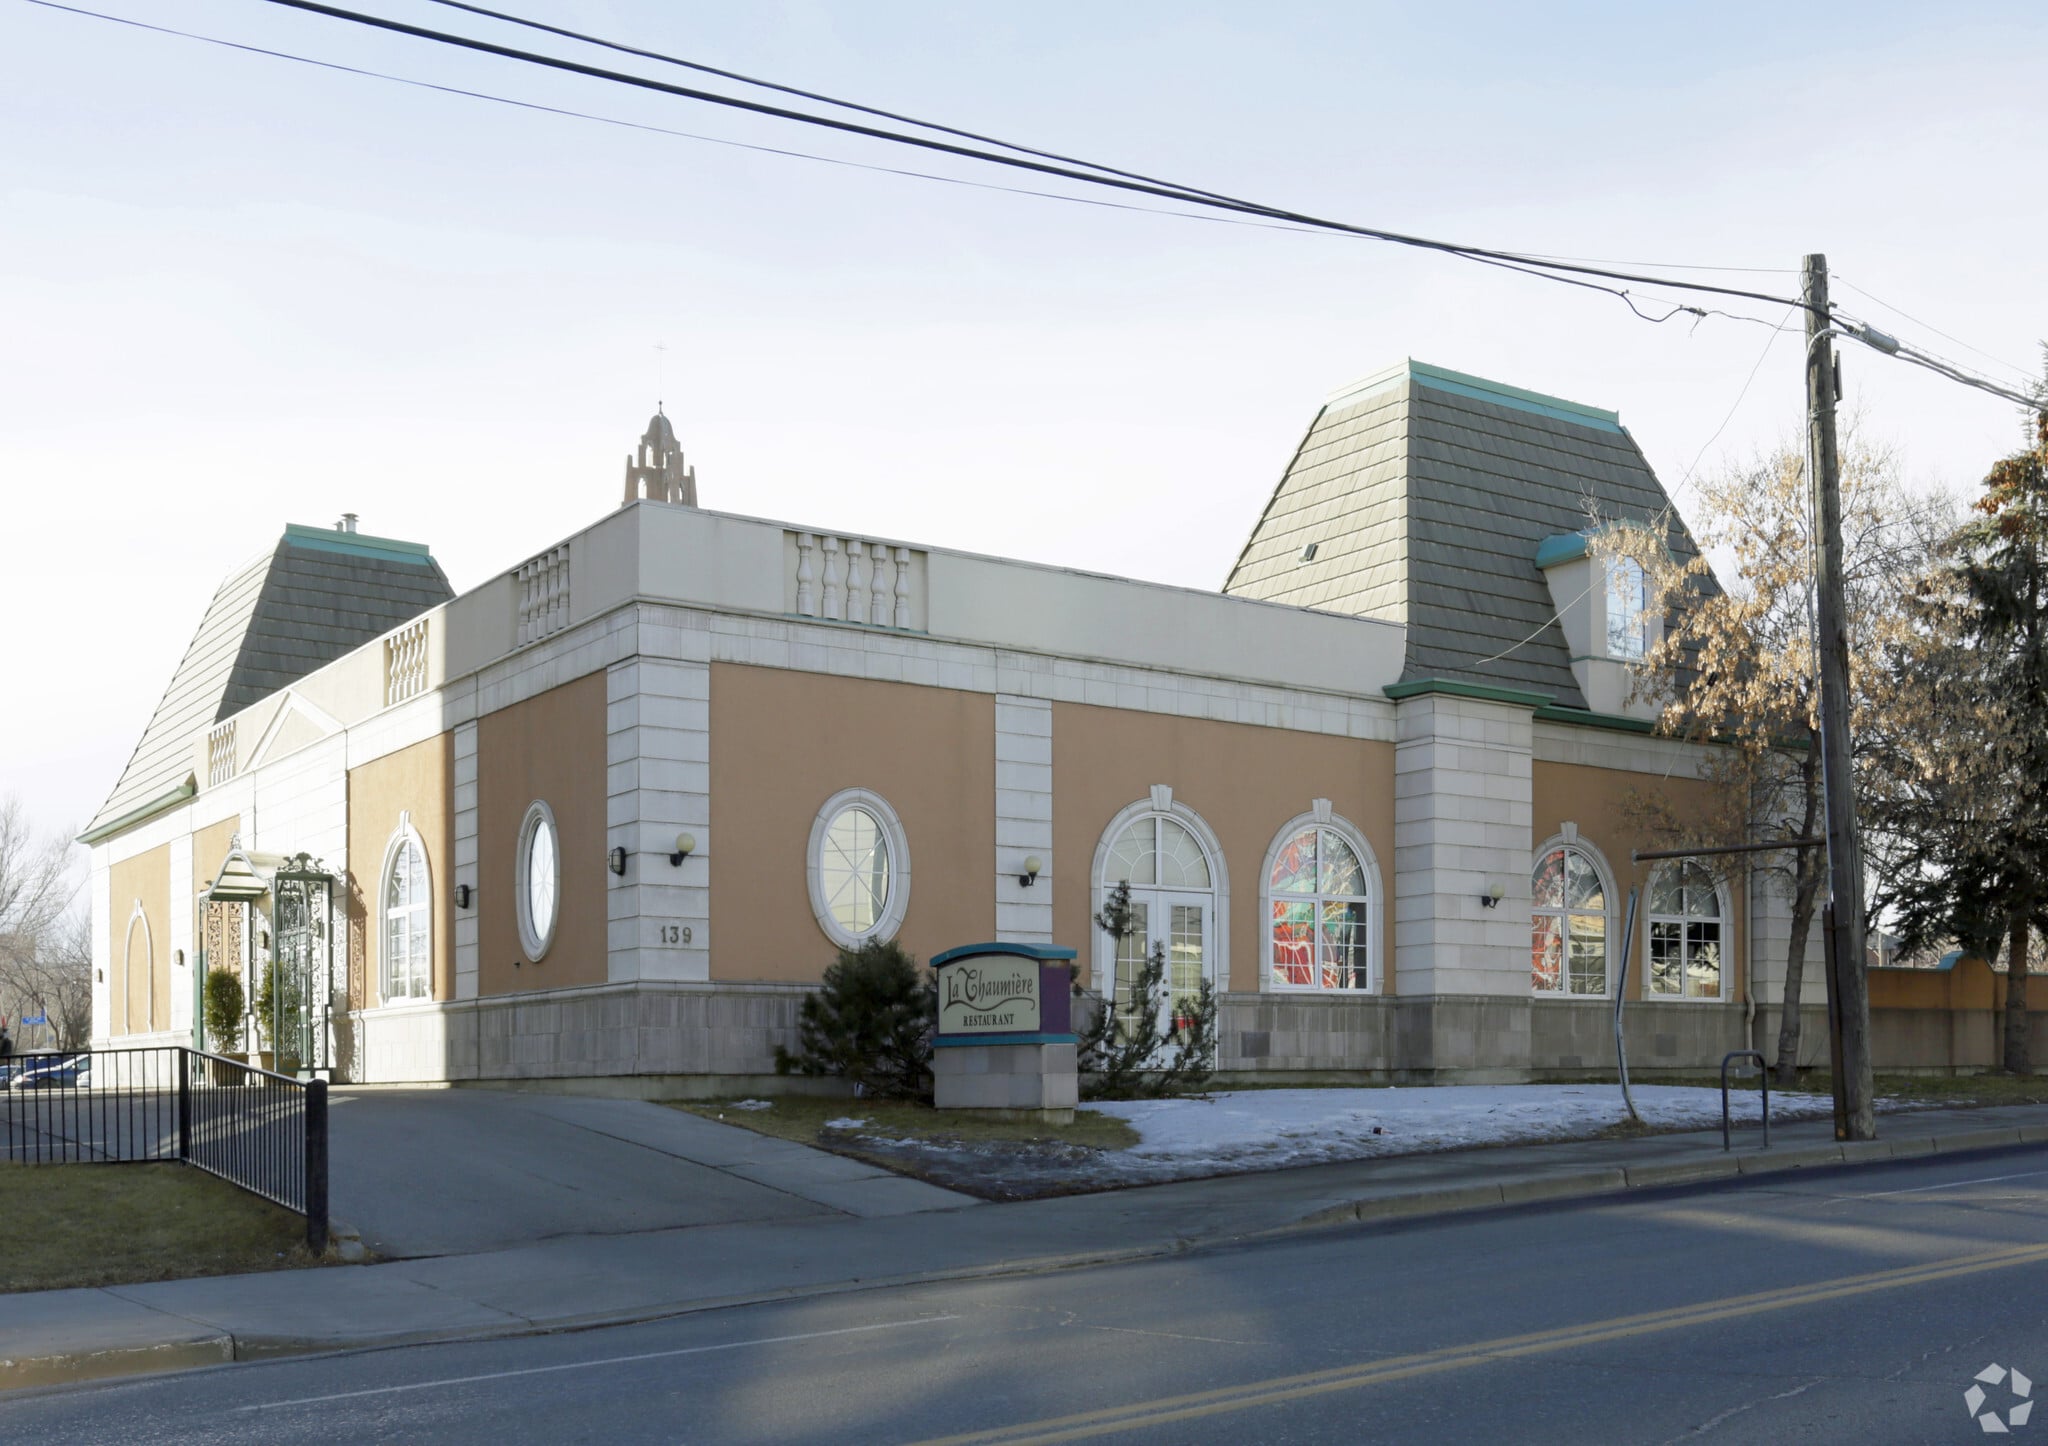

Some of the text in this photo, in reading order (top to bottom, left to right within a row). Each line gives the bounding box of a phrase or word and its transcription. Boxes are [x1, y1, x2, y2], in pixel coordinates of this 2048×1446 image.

[660, 925, 692, 944] 139
[945, 967, 1033, 1007] La Chaumière
[963, 1013, 1014, 1027] RESTAURANT
